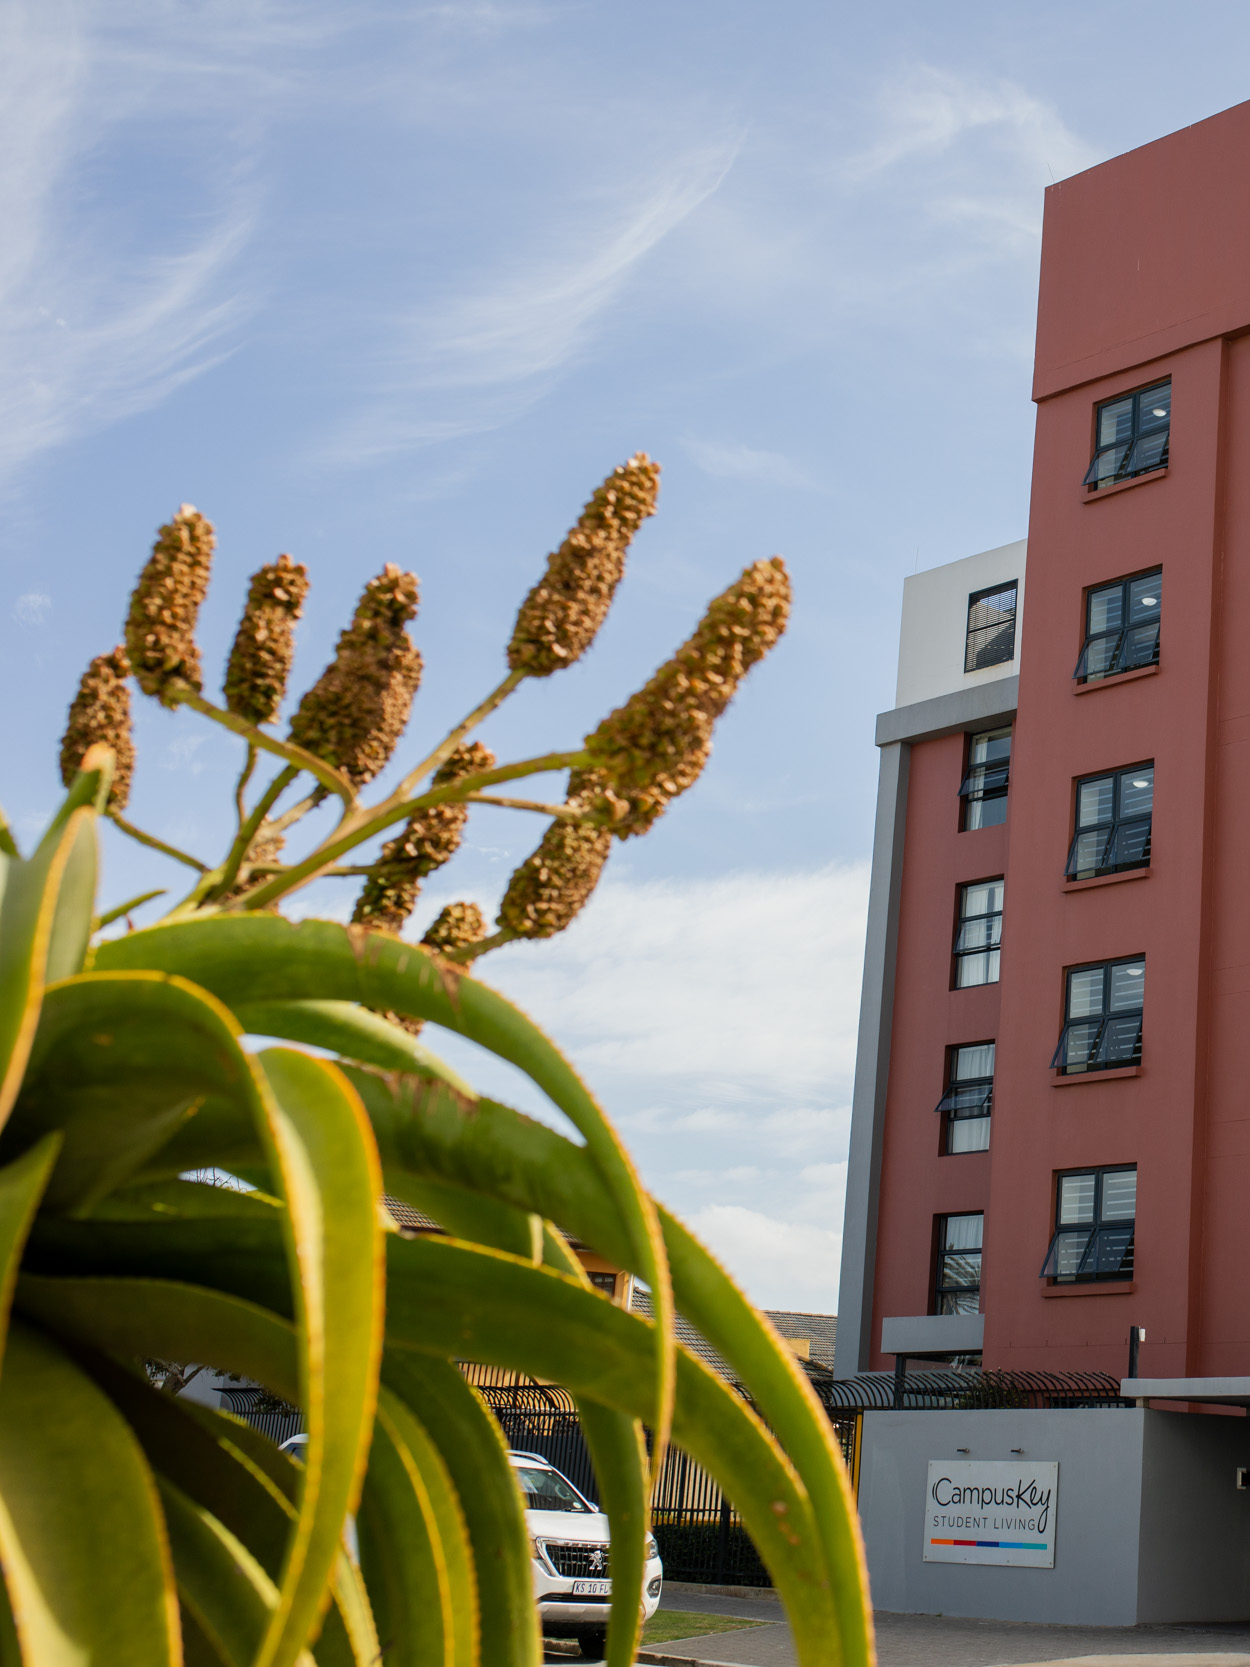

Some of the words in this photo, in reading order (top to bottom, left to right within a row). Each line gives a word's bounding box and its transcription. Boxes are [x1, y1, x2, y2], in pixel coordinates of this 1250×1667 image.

[932, 1477, 1051, 1534] CampusKey
[933, 1515, 988, 1529] STUDENT
[993, 1518, 1036, 1531] LIVING
[575, 1583, 585, 1594] KS
[588, 1583, 597, 1594] 10
